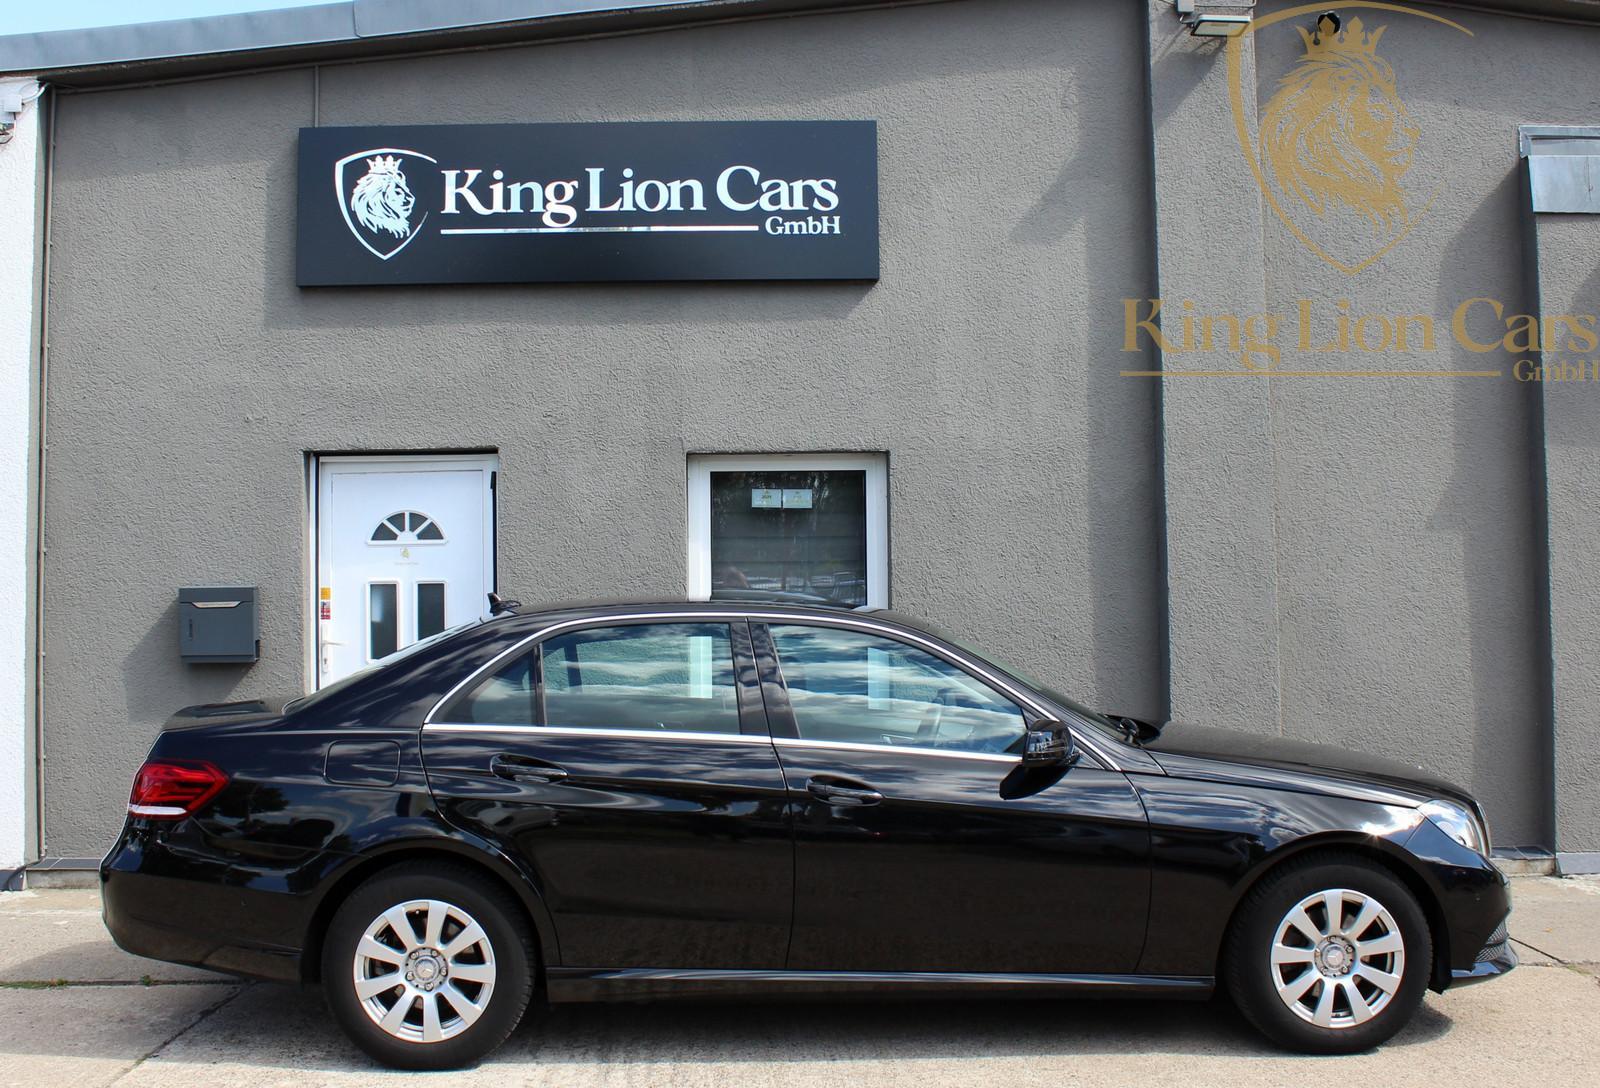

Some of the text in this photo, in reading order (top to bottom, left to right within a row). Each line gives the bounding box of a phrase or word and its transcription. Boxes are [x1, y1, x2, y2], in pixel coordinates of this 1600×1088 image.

[440, 165, 840, 228] King Lion Cars
[764, 215, 841, 236] GmbH
